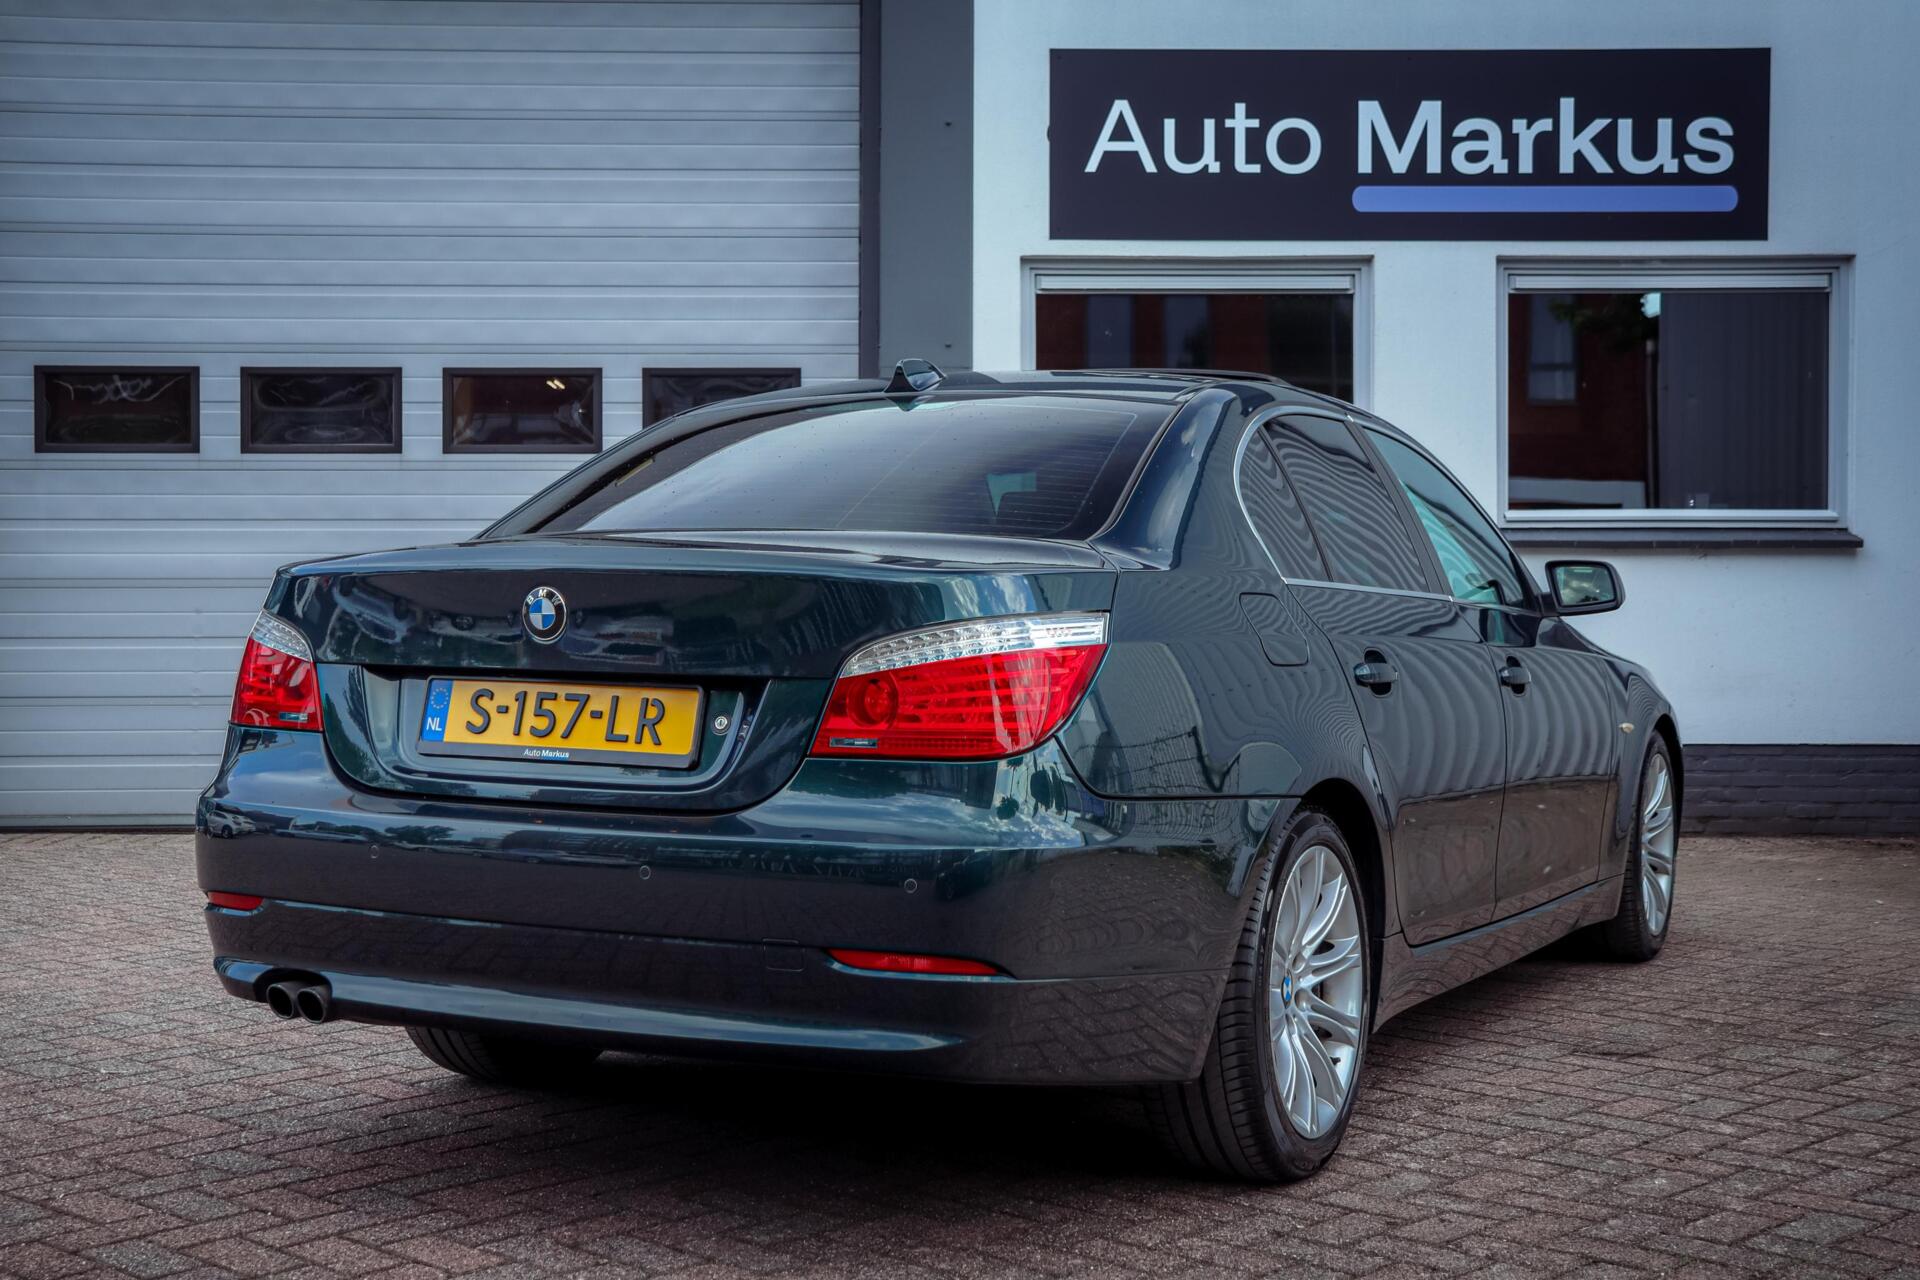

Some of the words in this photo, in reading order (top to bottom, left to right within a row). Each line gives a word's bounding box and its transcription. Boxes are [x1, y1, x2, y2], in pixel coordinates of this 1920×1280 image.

[1084, 98, 1322, 175] Auto
[1356, 96, 1736, 175] Markus
[526, 588, 562, 606] BMW
[426, 716, 442, 732] NL
[465, 688, 665, 745] S-157-LR
[523, 748, 541, 757] Auto
[541, 749, 570, 758] Markus
